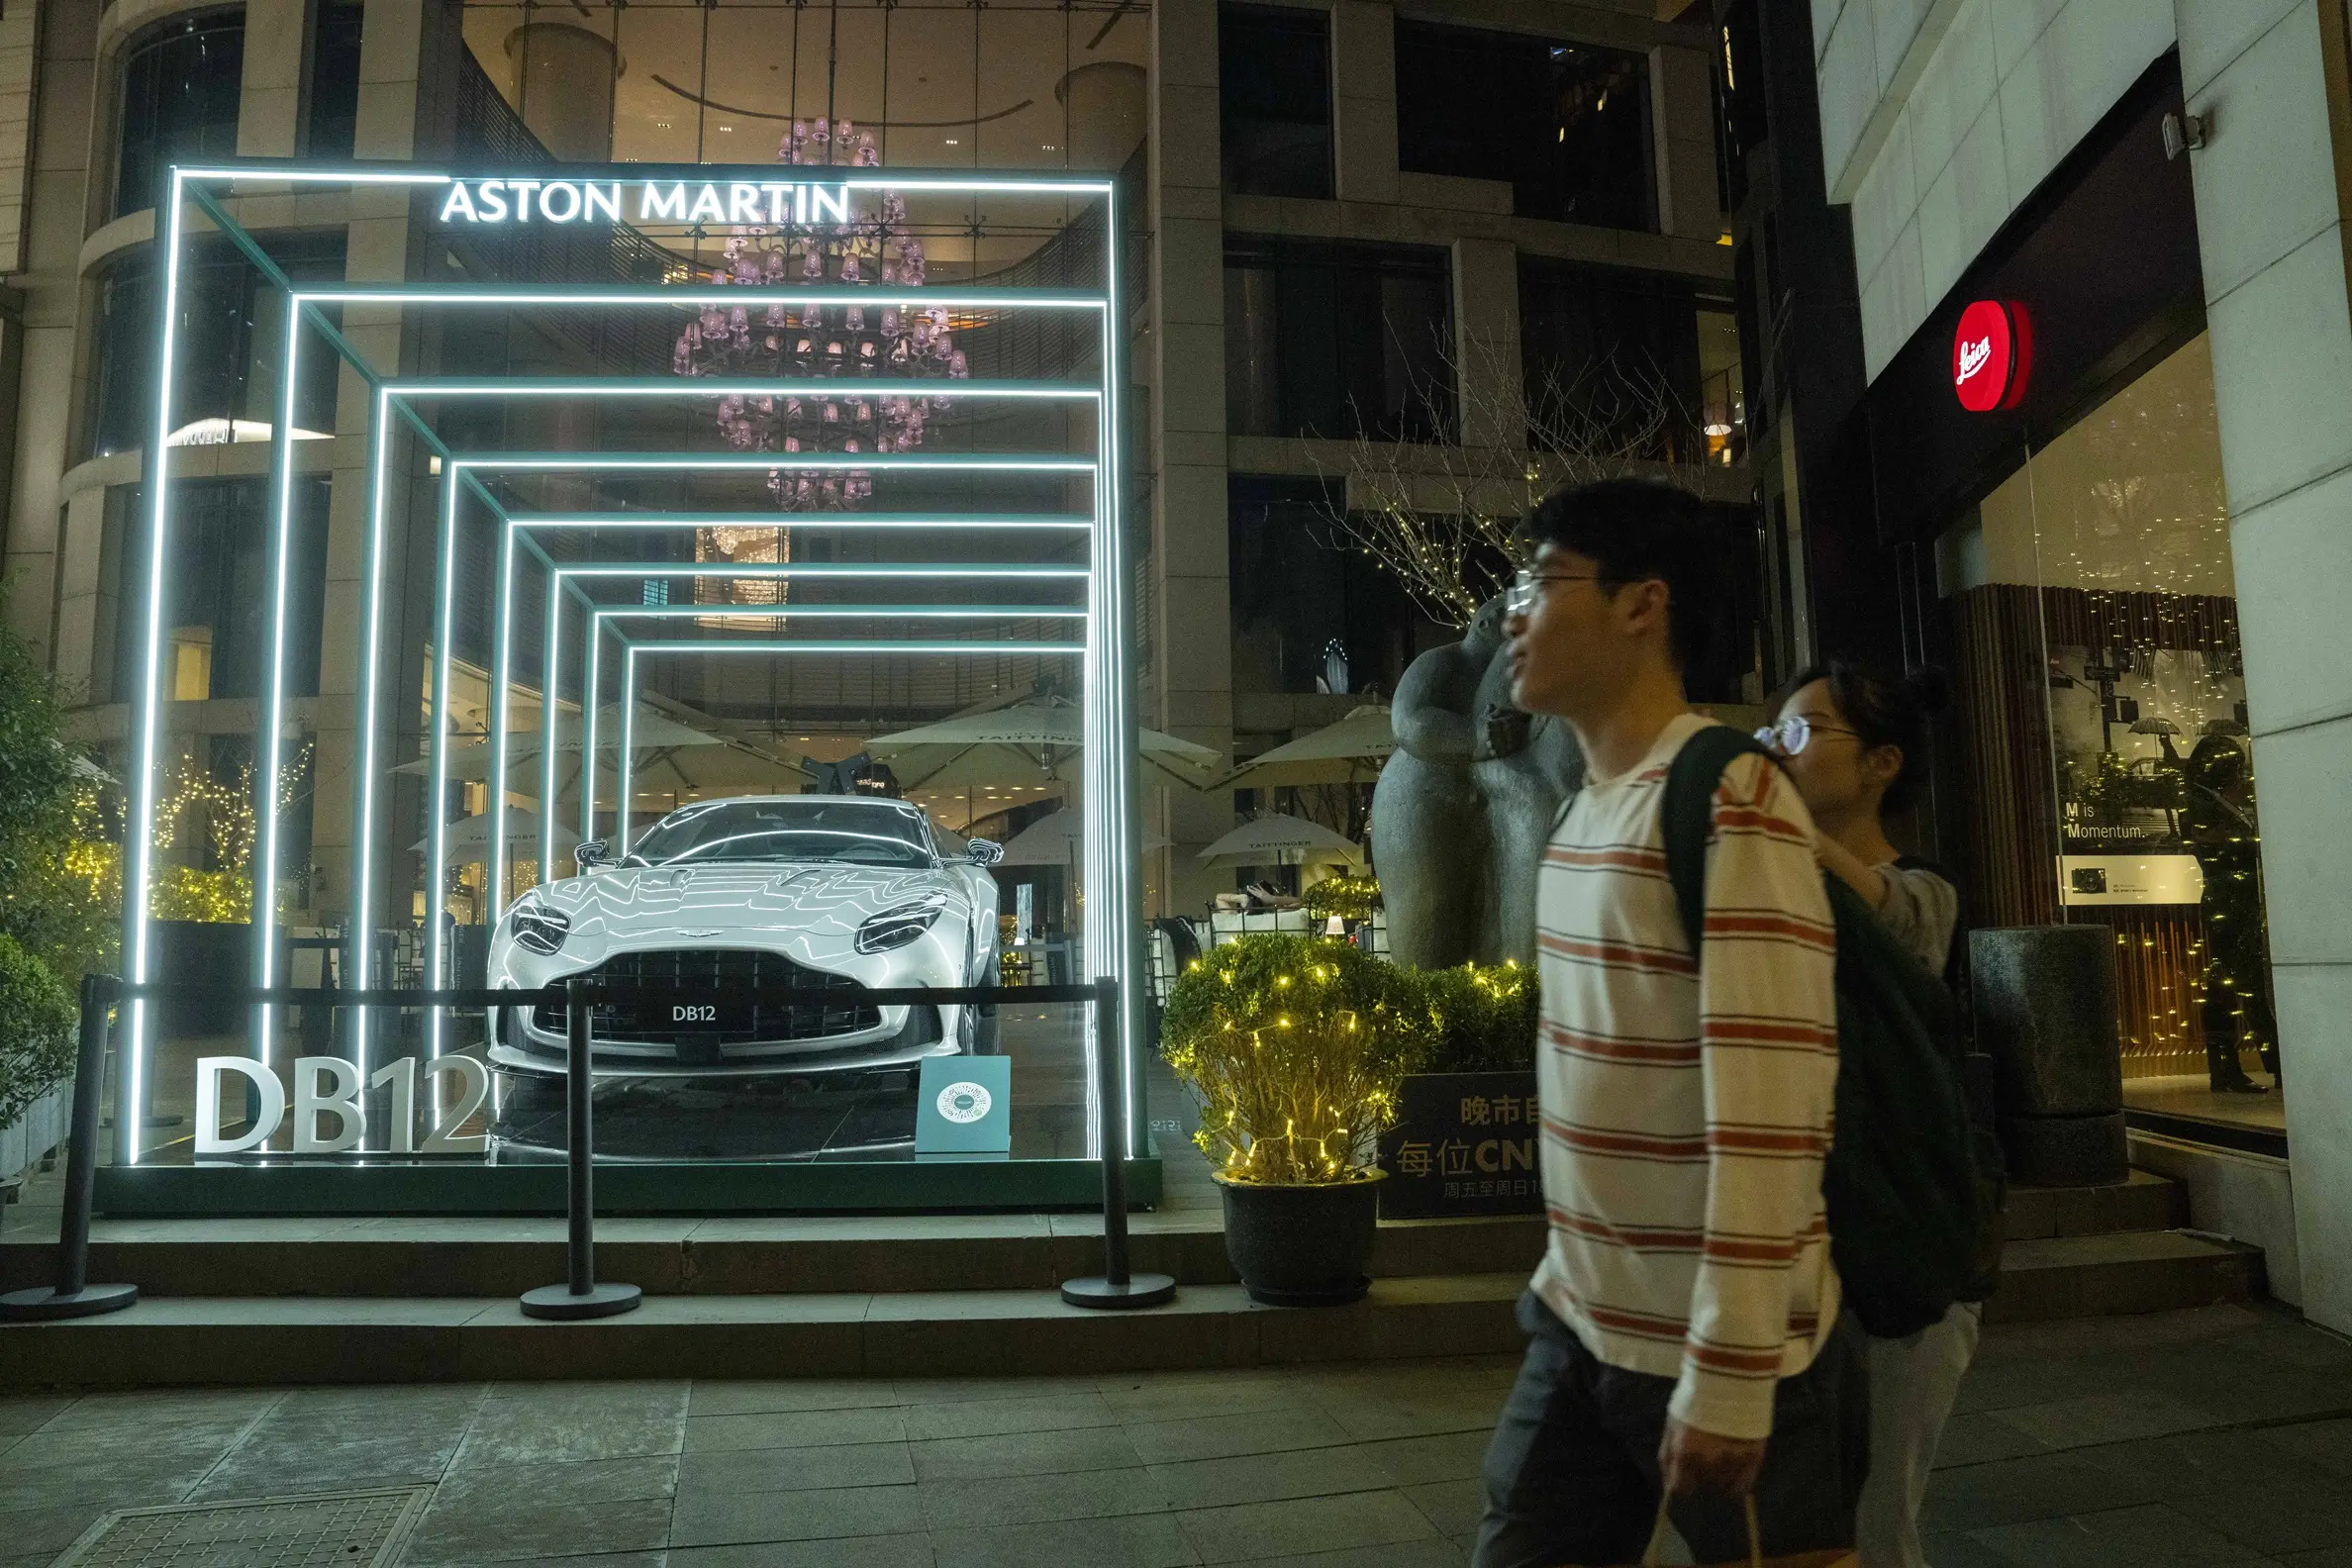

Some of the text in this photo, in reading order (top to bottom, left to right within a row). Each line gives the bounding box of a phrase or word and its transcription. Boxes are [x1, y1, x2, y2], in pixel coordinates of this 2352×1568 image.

[441, 180, 849, 224] ASTON MARTIN
[1956, 336, 1991, 385] Leica
[2065, 802, 2095, 818] M is
[2067, 823, 2146, 838] Momentum.
[672, 1005, 716, 1022] DB12
[194, 1055, 489, 1154] DB12
[1397, 1138, 1534, 1178] 每位CN
